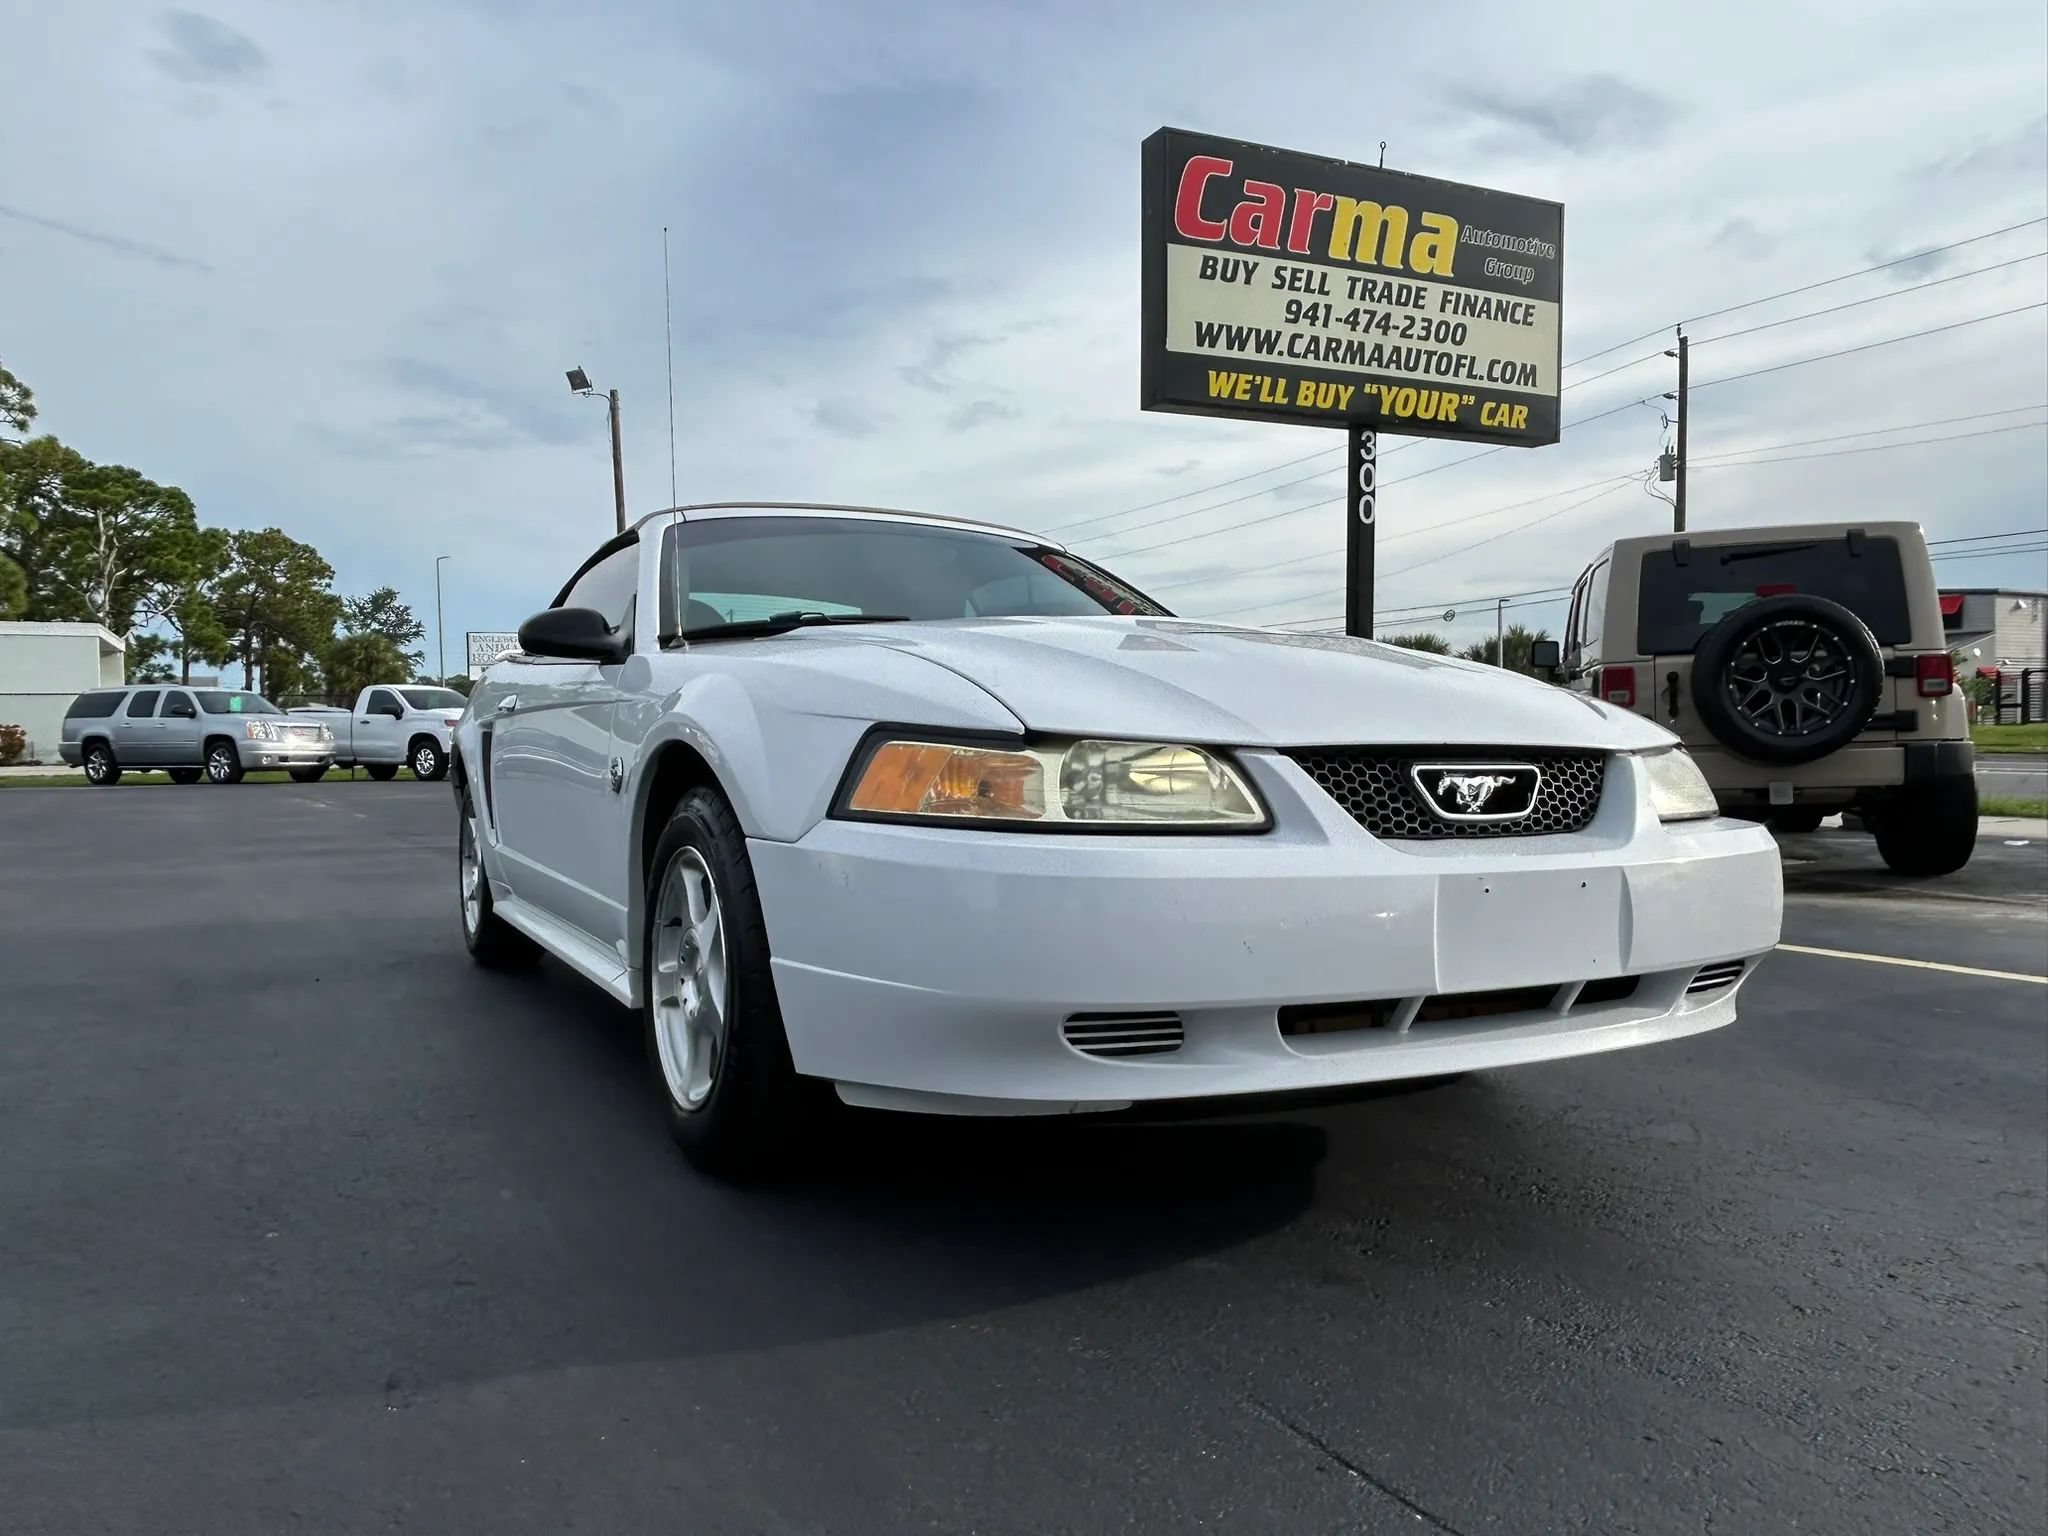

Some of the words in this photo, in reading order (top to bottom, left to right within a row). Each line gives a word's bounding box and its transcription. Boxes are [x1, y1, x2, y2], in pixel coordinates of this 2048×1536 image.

[1174, 155, 1459, 277] Carma
[1461, 225, 1556, 259] Automotive
[1200, 254, 1260, 285] BUY
[1271, 265, 1331, 296] SELL
[1346, 275, 1428, 310] TRADE
[1439, 290, 1536, 326] FINANCE
[1484, 257, 1535, 284] Group
[1195, 320, 1538, 388] WWW.CARMAAUTOFL.COM
[1284, 299, 1467, 346] 941-474-2300
[1208, 370, 1289, 405] WE'LL
[1296, 380, 1355, 411] BUY
[1480, 401, 1529, 429] CAR
[1359, 430, 1376, 524] 300
